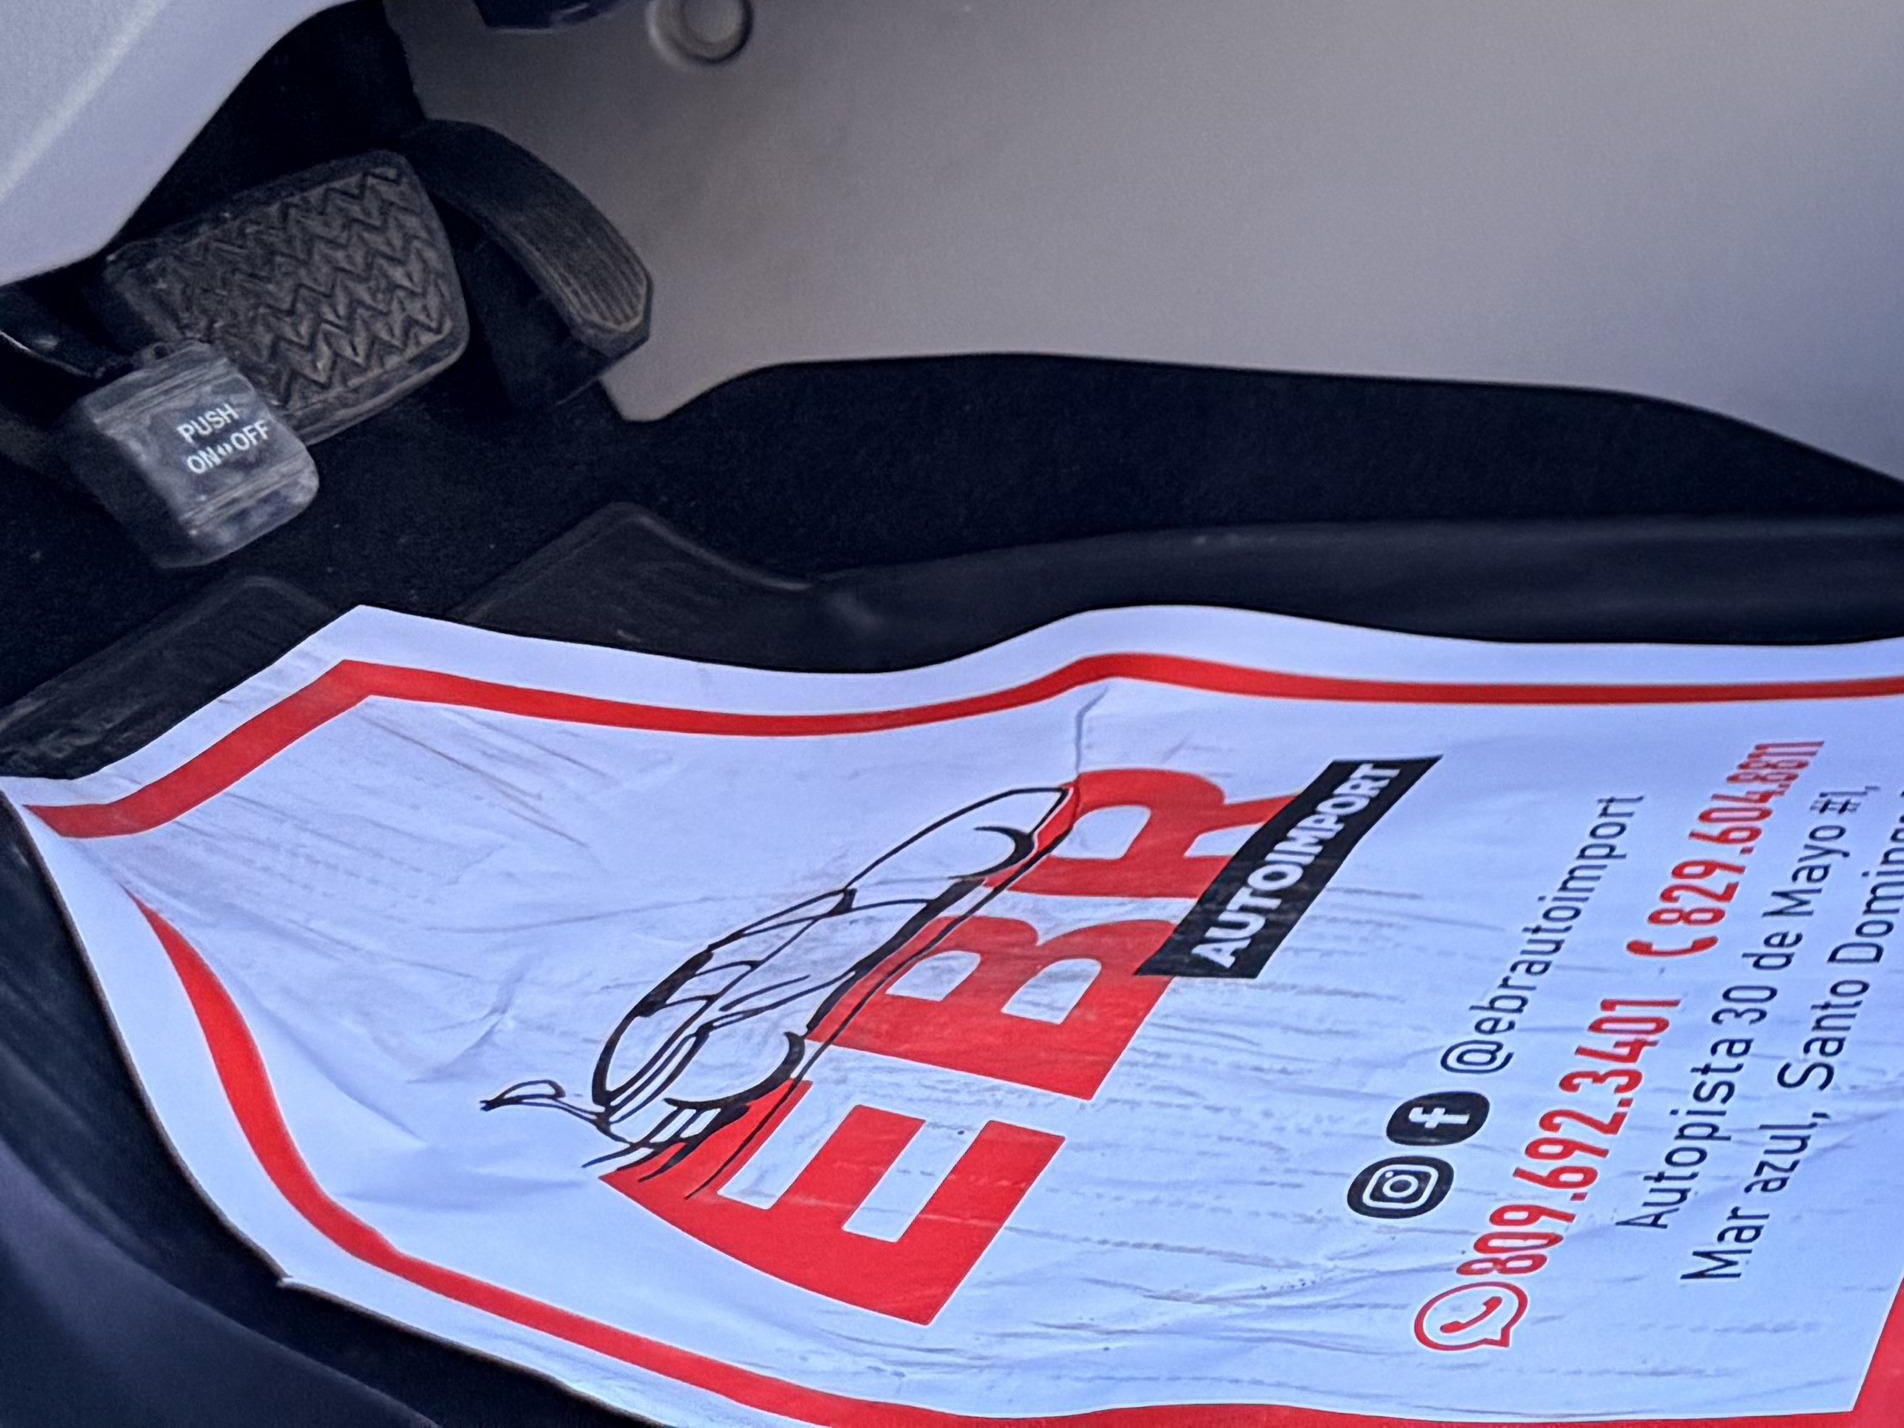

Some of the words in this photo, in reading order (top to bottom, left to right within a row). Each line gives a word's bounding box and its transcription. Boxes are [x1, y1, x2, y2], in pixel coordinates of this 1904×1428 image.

[177, 403, 241, 445] PUSH
[1191, 763, 1402, 968] AUTOIMPORT
[1762, 825, 1850, 917] Mayo
[1440, 795, 1644, 1074] @ebrautoimport
[1742, 931, 1803, 971] de
[599, 768, 1302, 1325] EBR
[1456, 999, 1681, 1277] 809.692.3401
[1648, 740, 1824, 927] 829.604.8811
[1711, 985, 1777, 1026] 30
[1777, 980, 1870, 1091] Santo
[1615, 1038, 1754, 1229] Autopista
[1744, 1111, 1831, 1194] azul,
[1680, 1207, 1770, 1281] Mar
